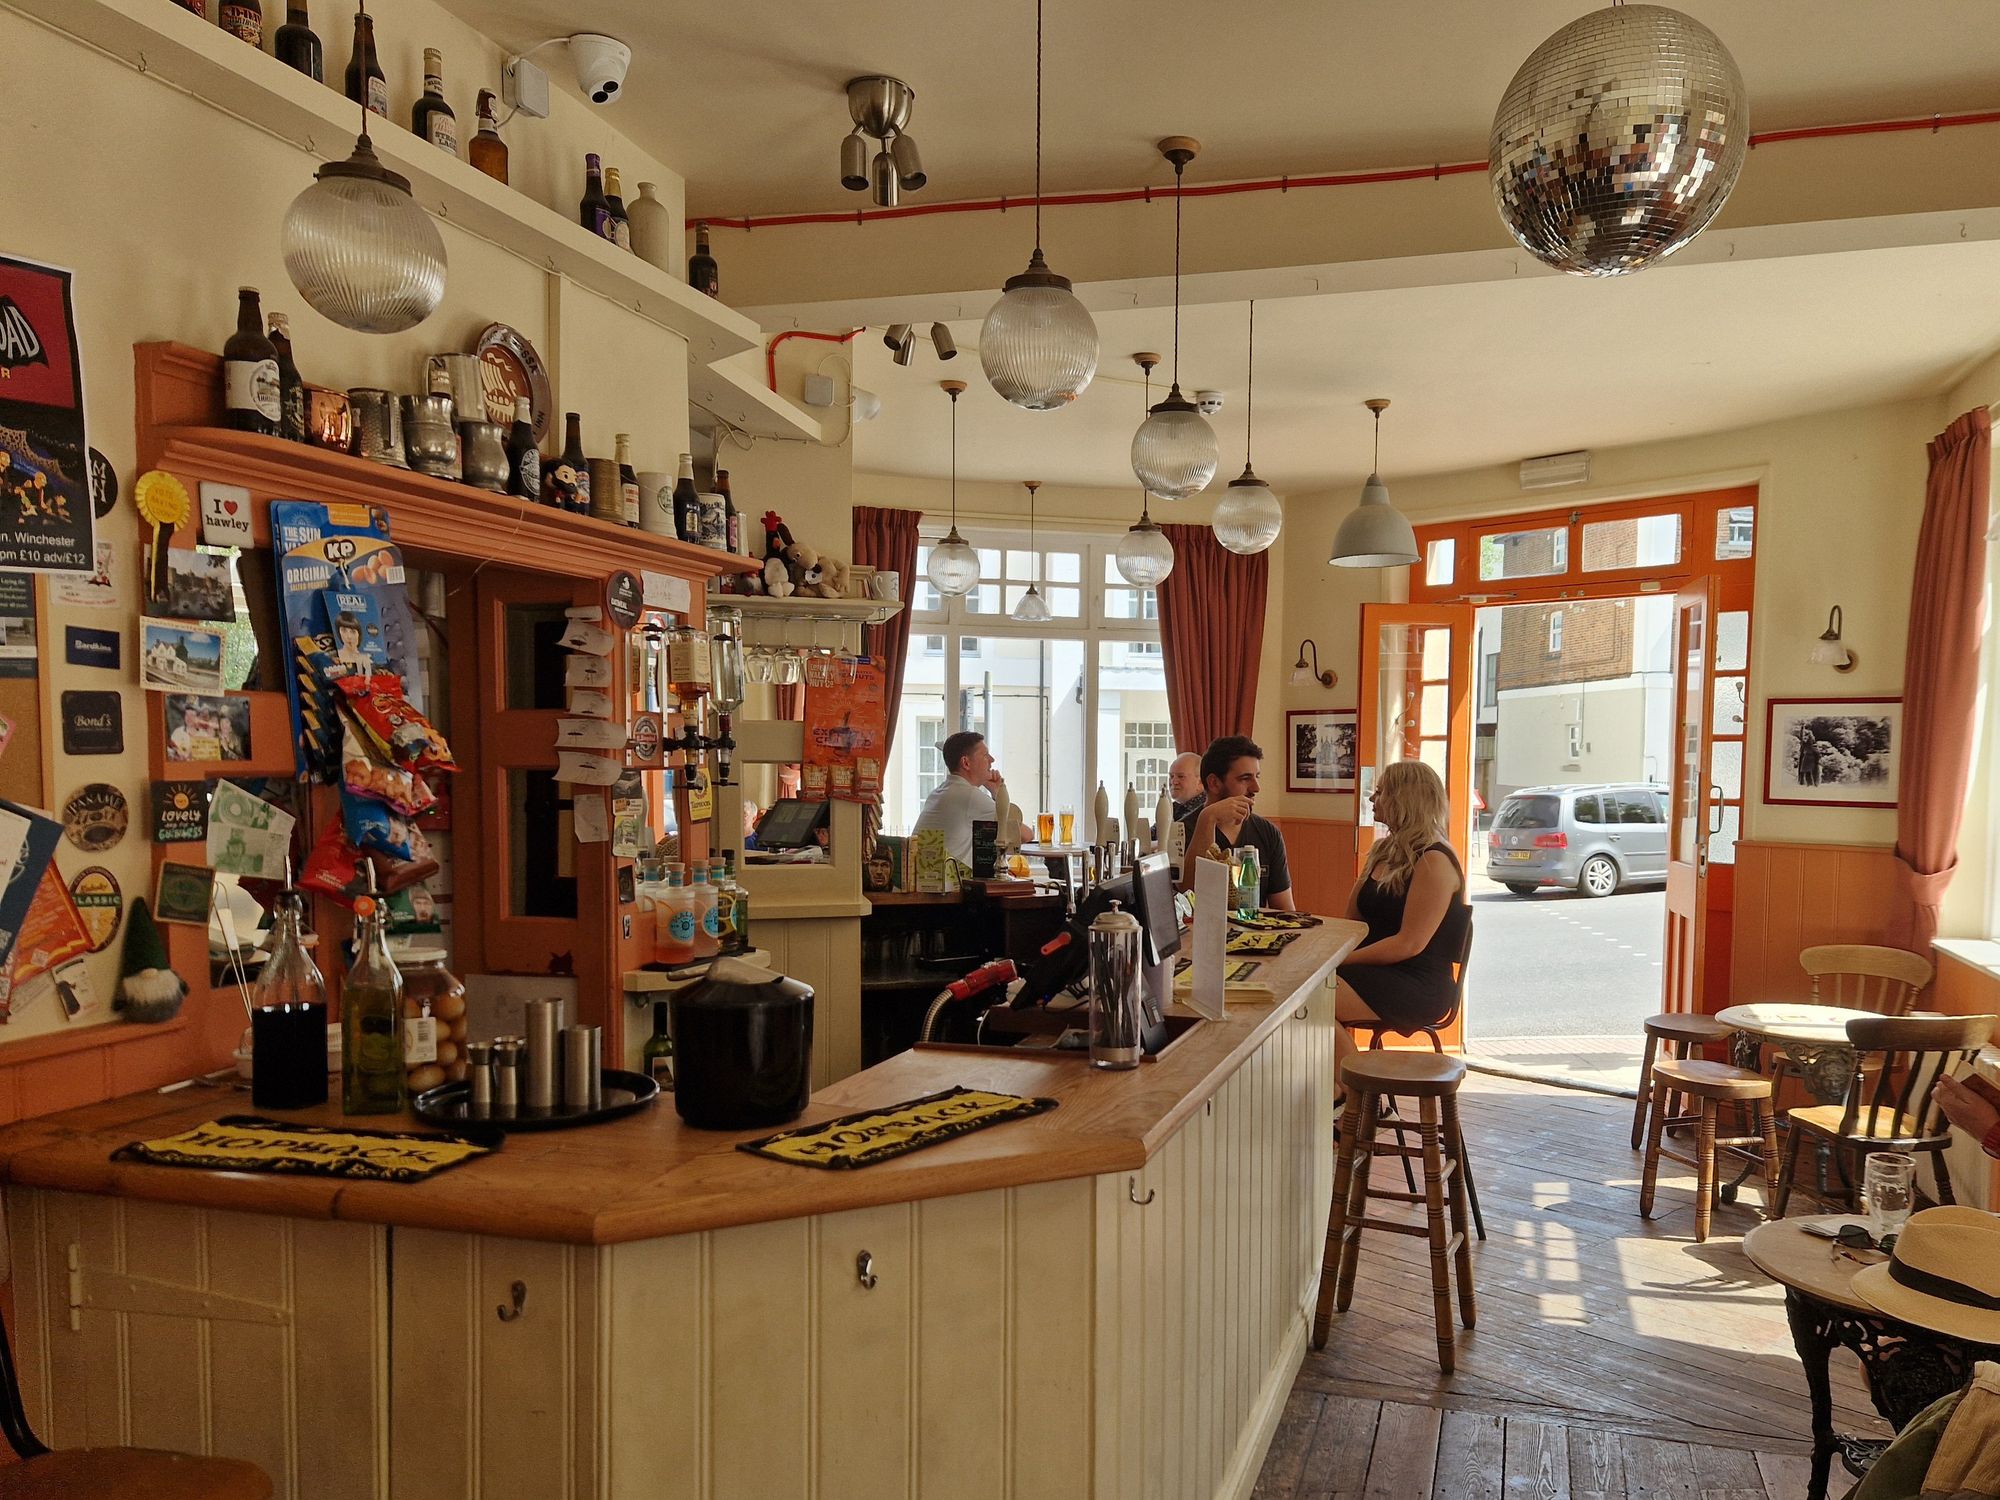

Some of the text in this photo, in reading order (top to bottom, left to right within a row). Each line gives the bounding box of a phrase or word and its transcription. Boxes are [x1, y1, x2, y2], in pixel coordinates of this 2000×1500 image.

[213, 499, 221, 514] I
[206, 515, 249, 532] hawley
[15, 531, 75, 547] Winchester
[20, 549, 40, 562] £10
[44, 551, 85, 565] adv/£12
[327, 542, 354, 559] KP
[287, 566, 330, 584] ORIGINAL
